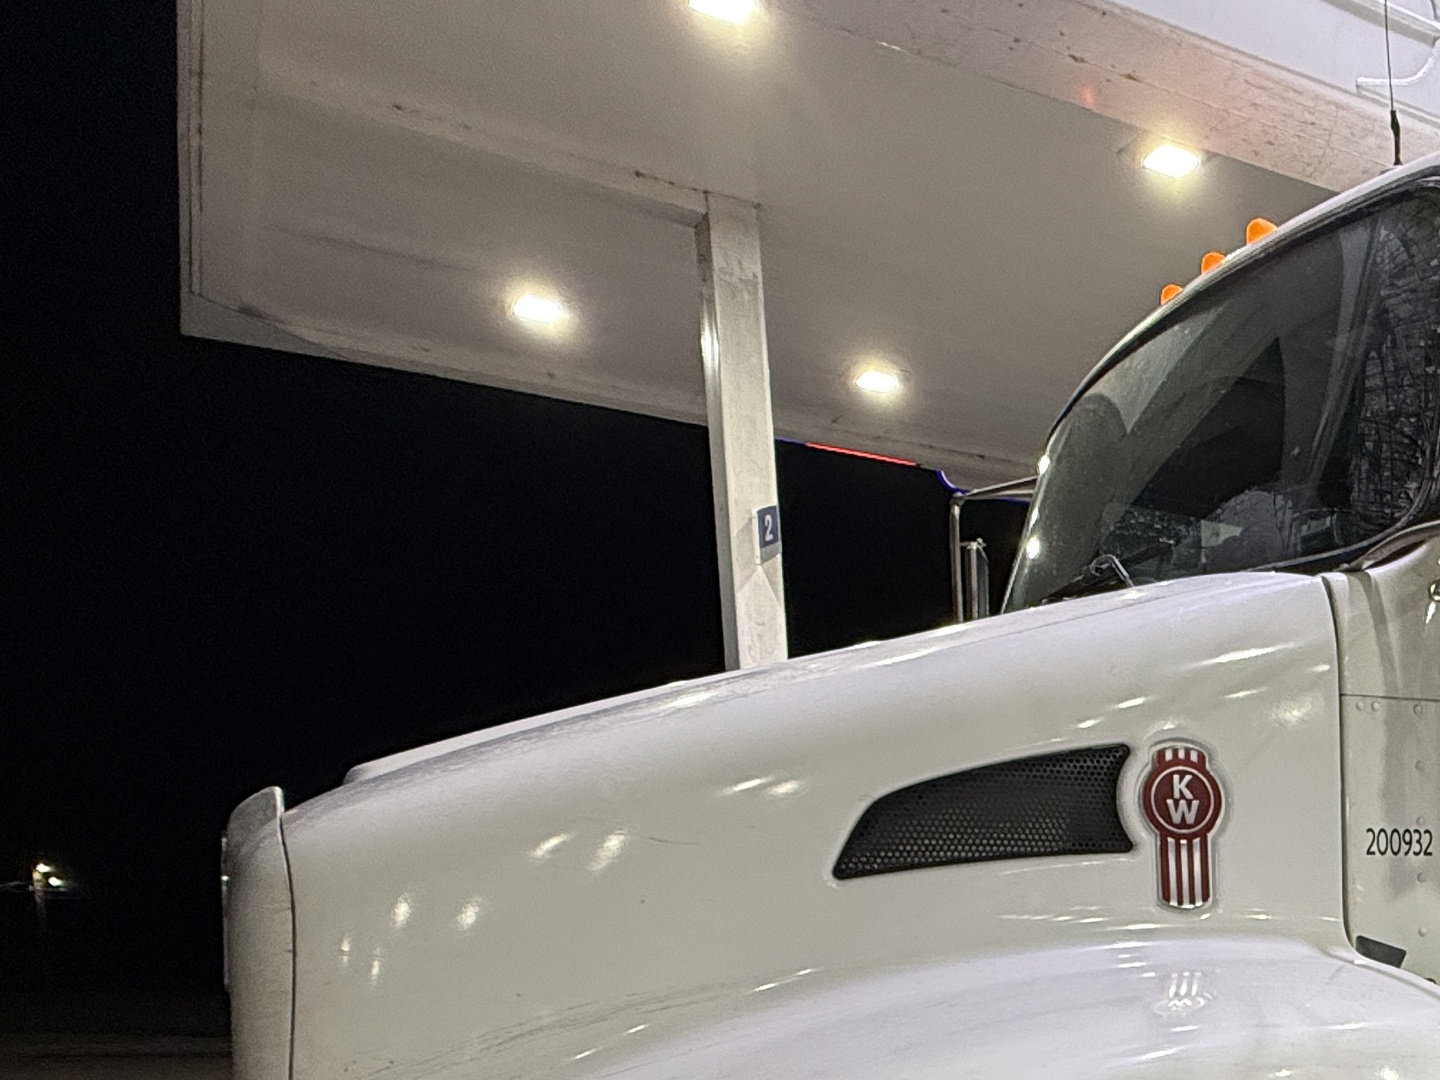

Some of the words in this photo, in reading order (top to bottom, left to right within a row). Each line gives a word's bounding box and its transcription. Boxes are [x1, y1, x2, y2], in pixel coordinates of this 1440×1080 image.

[764, 514, 774, 542] 2
[1172, 774, 1194, 800] K
[1165, 799, 1200, 824] W
[1365, 828, 1433, 857] 200932
